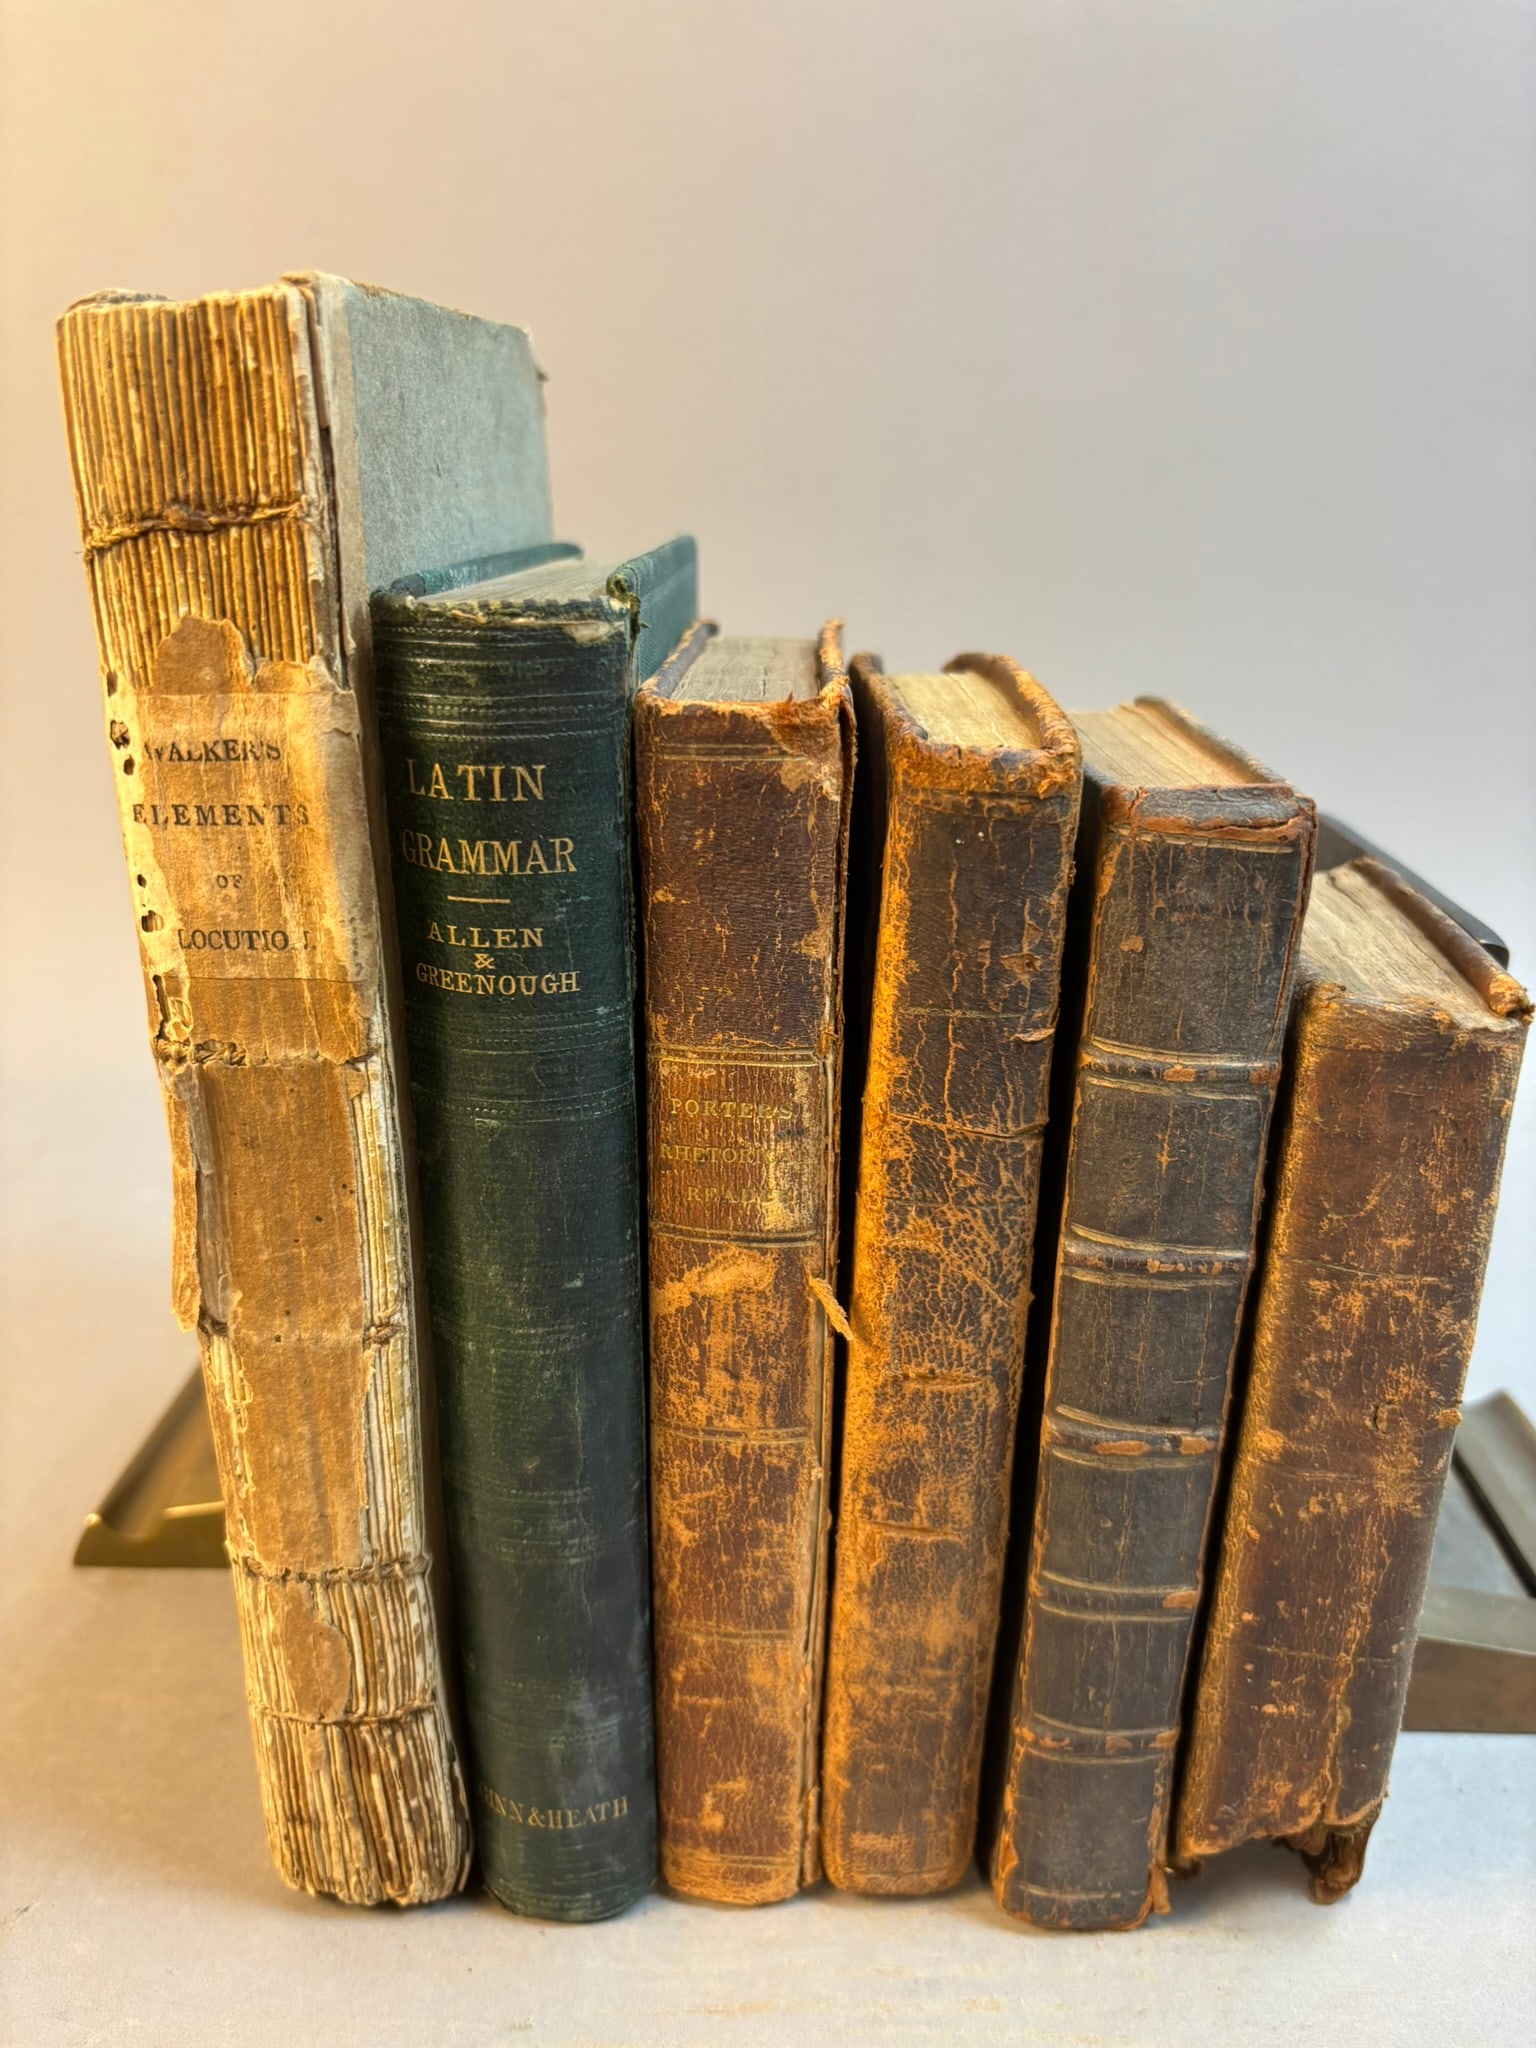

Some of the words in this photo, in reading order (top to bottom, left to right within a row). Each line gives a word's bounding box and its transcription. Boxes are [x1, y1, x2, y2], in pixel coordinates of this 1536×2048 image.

[407, 758, 547, 802] LATIN
[133, 804, 309, 826] ELEMENTS
[402, 828, 577, 875] GRAMMAR
[216, 874, 243, 889] OF
[427, 921, 544, 948] ALLEN
[473, 953, 495, 970] &
[416, 962, 580, 996] GREENOUGH
